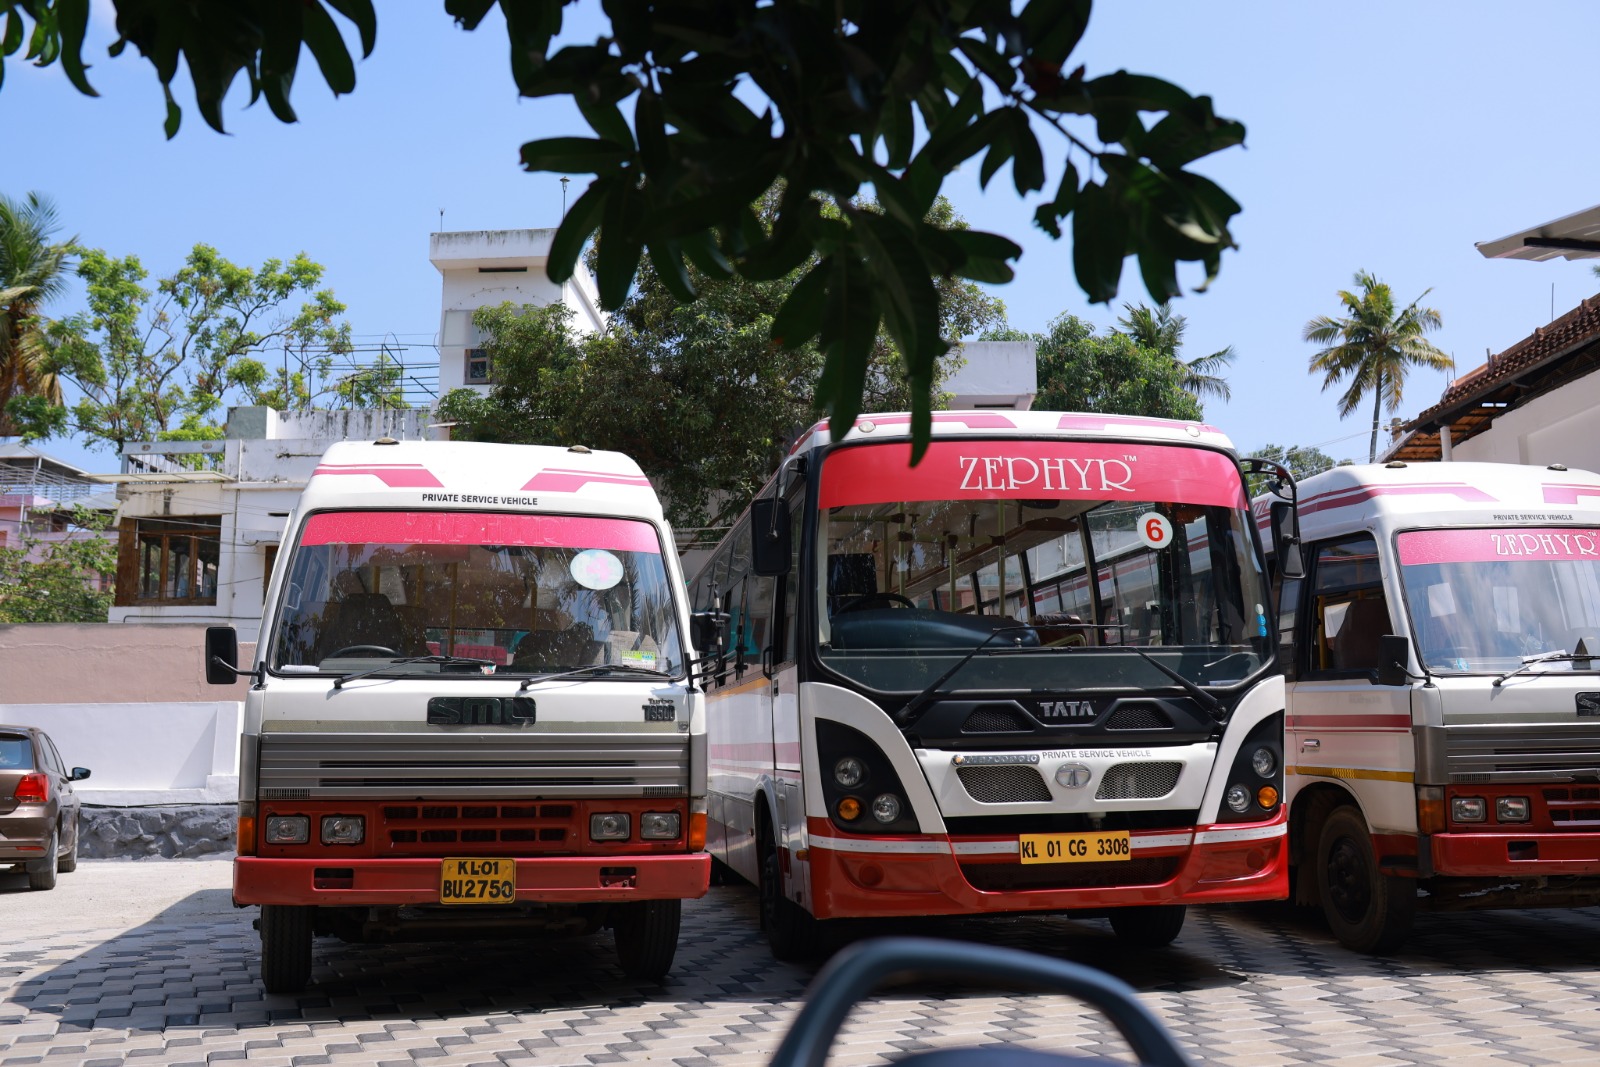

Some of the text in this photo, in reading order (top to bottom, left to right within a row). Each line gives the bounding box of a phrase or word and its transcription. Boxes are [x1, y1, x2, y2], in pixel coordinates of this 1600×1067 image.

[959, 455, 1136, 492] ZEPHYR
[422, 493, 538, 506] PRIVATE SERVICE VEHICLE
[1145, 518, 1164, 542] 6
[1490, 533, 1599, 556] ZEPHYR
[1039, 701, 1095, 717] TATA
[1042, 749, 1152, 759] PRIVATE SERVICE VEHICLE
[1021, 838, 1129, 858] KL 01 CG 3308
